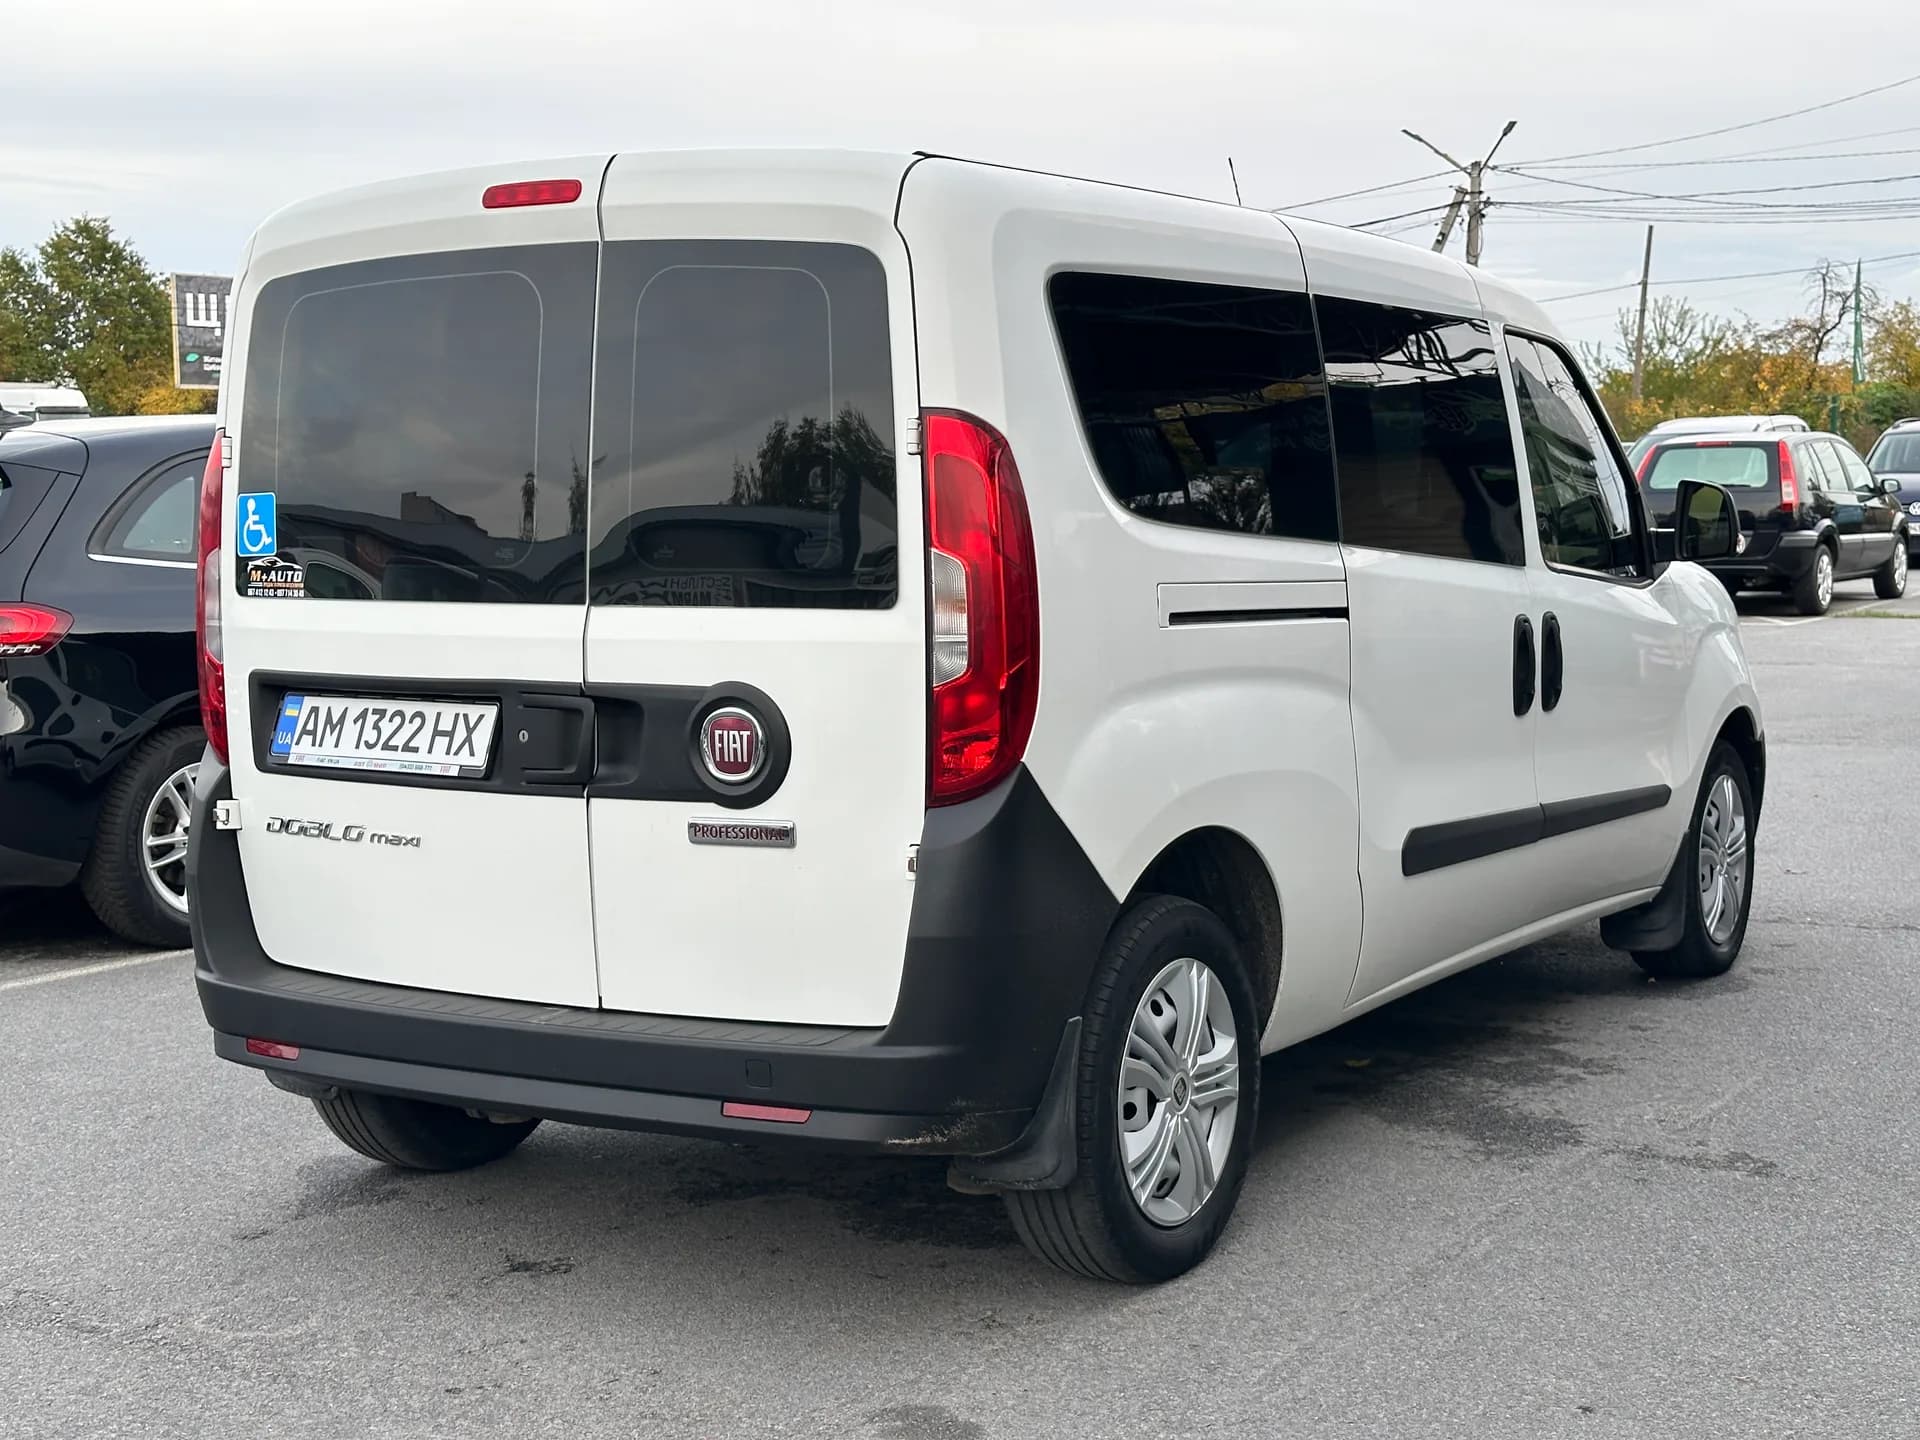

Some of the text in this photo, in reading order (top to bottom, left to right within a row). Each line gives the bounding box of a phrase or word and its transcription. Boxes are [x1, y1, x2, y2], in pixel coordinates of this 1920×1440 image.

[250, 570, 303, 582] M+AUTO
[278, 731, 292, 745] UA
[295, 705, 486, 757] AM 1322 HX
[715, 729, 751, 763] FIAT
[266, 816, 422, 848] DOBLO maxi
[693, 825, 785, 842] PROFESSIONAL
